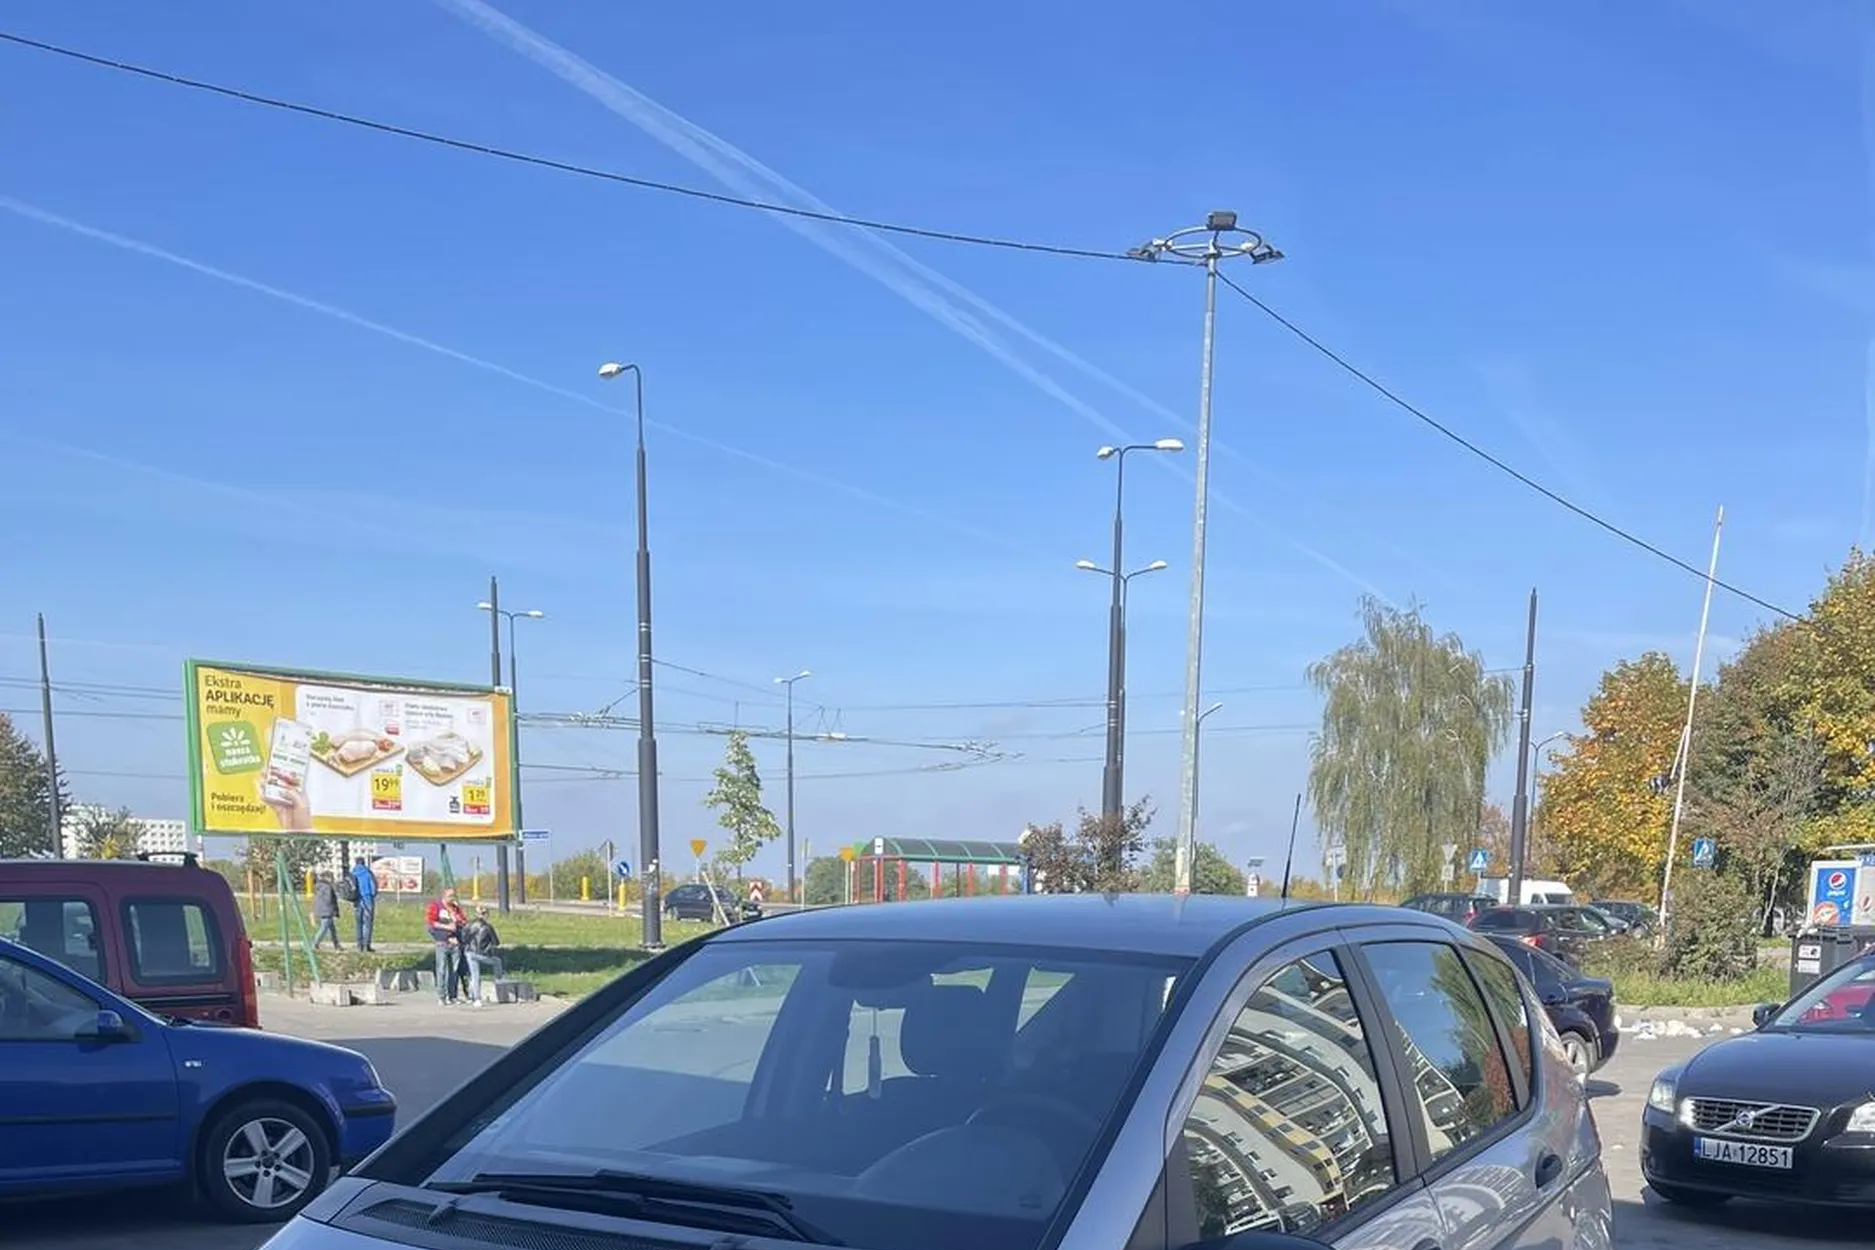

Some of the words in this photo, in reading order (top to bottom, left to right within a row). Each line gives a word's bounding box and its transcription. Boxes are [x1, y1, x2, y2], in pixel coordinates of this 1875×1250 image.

[204, 674, 242, 690] Ekstra
[206, 690, 275, 709] APLIKACJĘ
[206, 705, 241, 718] mamy
[1703, 1141, 1731, 1160] LJA
[1739, 1145, 1788, 1167] 12851
